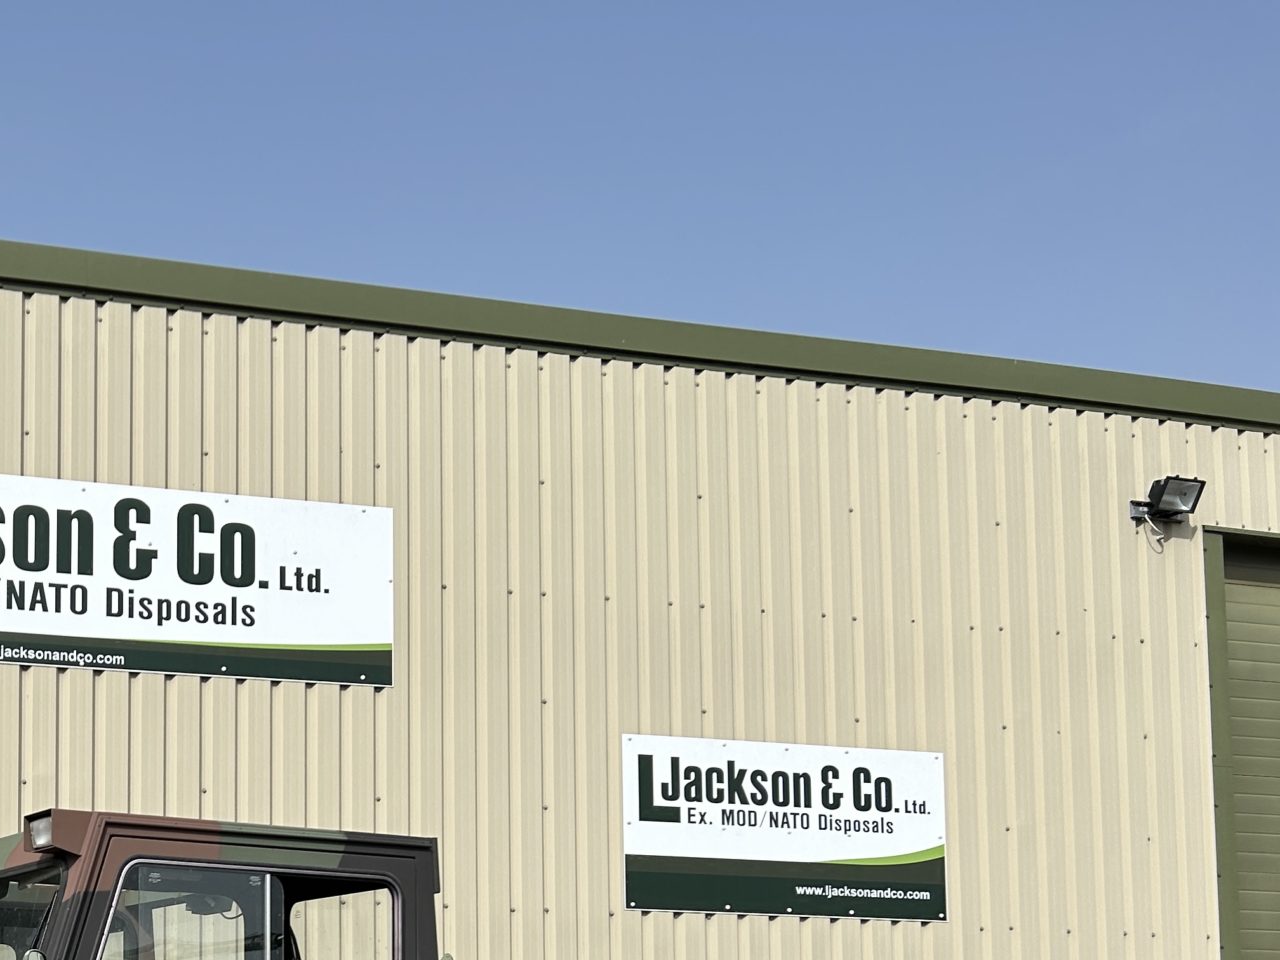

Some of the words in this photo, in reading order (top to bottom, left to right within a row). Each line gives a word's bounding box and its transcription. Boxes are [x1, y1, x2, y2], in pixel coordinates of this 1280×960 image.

[113, 497, 158, 580] &
[176, 502, 268, 589] Co.
[279, 565, 330, 594] Ltd.
[106, 587, 256, 628] Disposals
[821, 765, 844, 810] &
[853, 767, 900, 813] Co.
[904, 800, 931, 815] Ltd.
[688, 807, 713, 825] Ex.
[721, 809, 810, 830] MOD/NATO
[819, 813, 894, 834] Disposals
[796, 885, 931, 900] www.ljacksonandco.com
